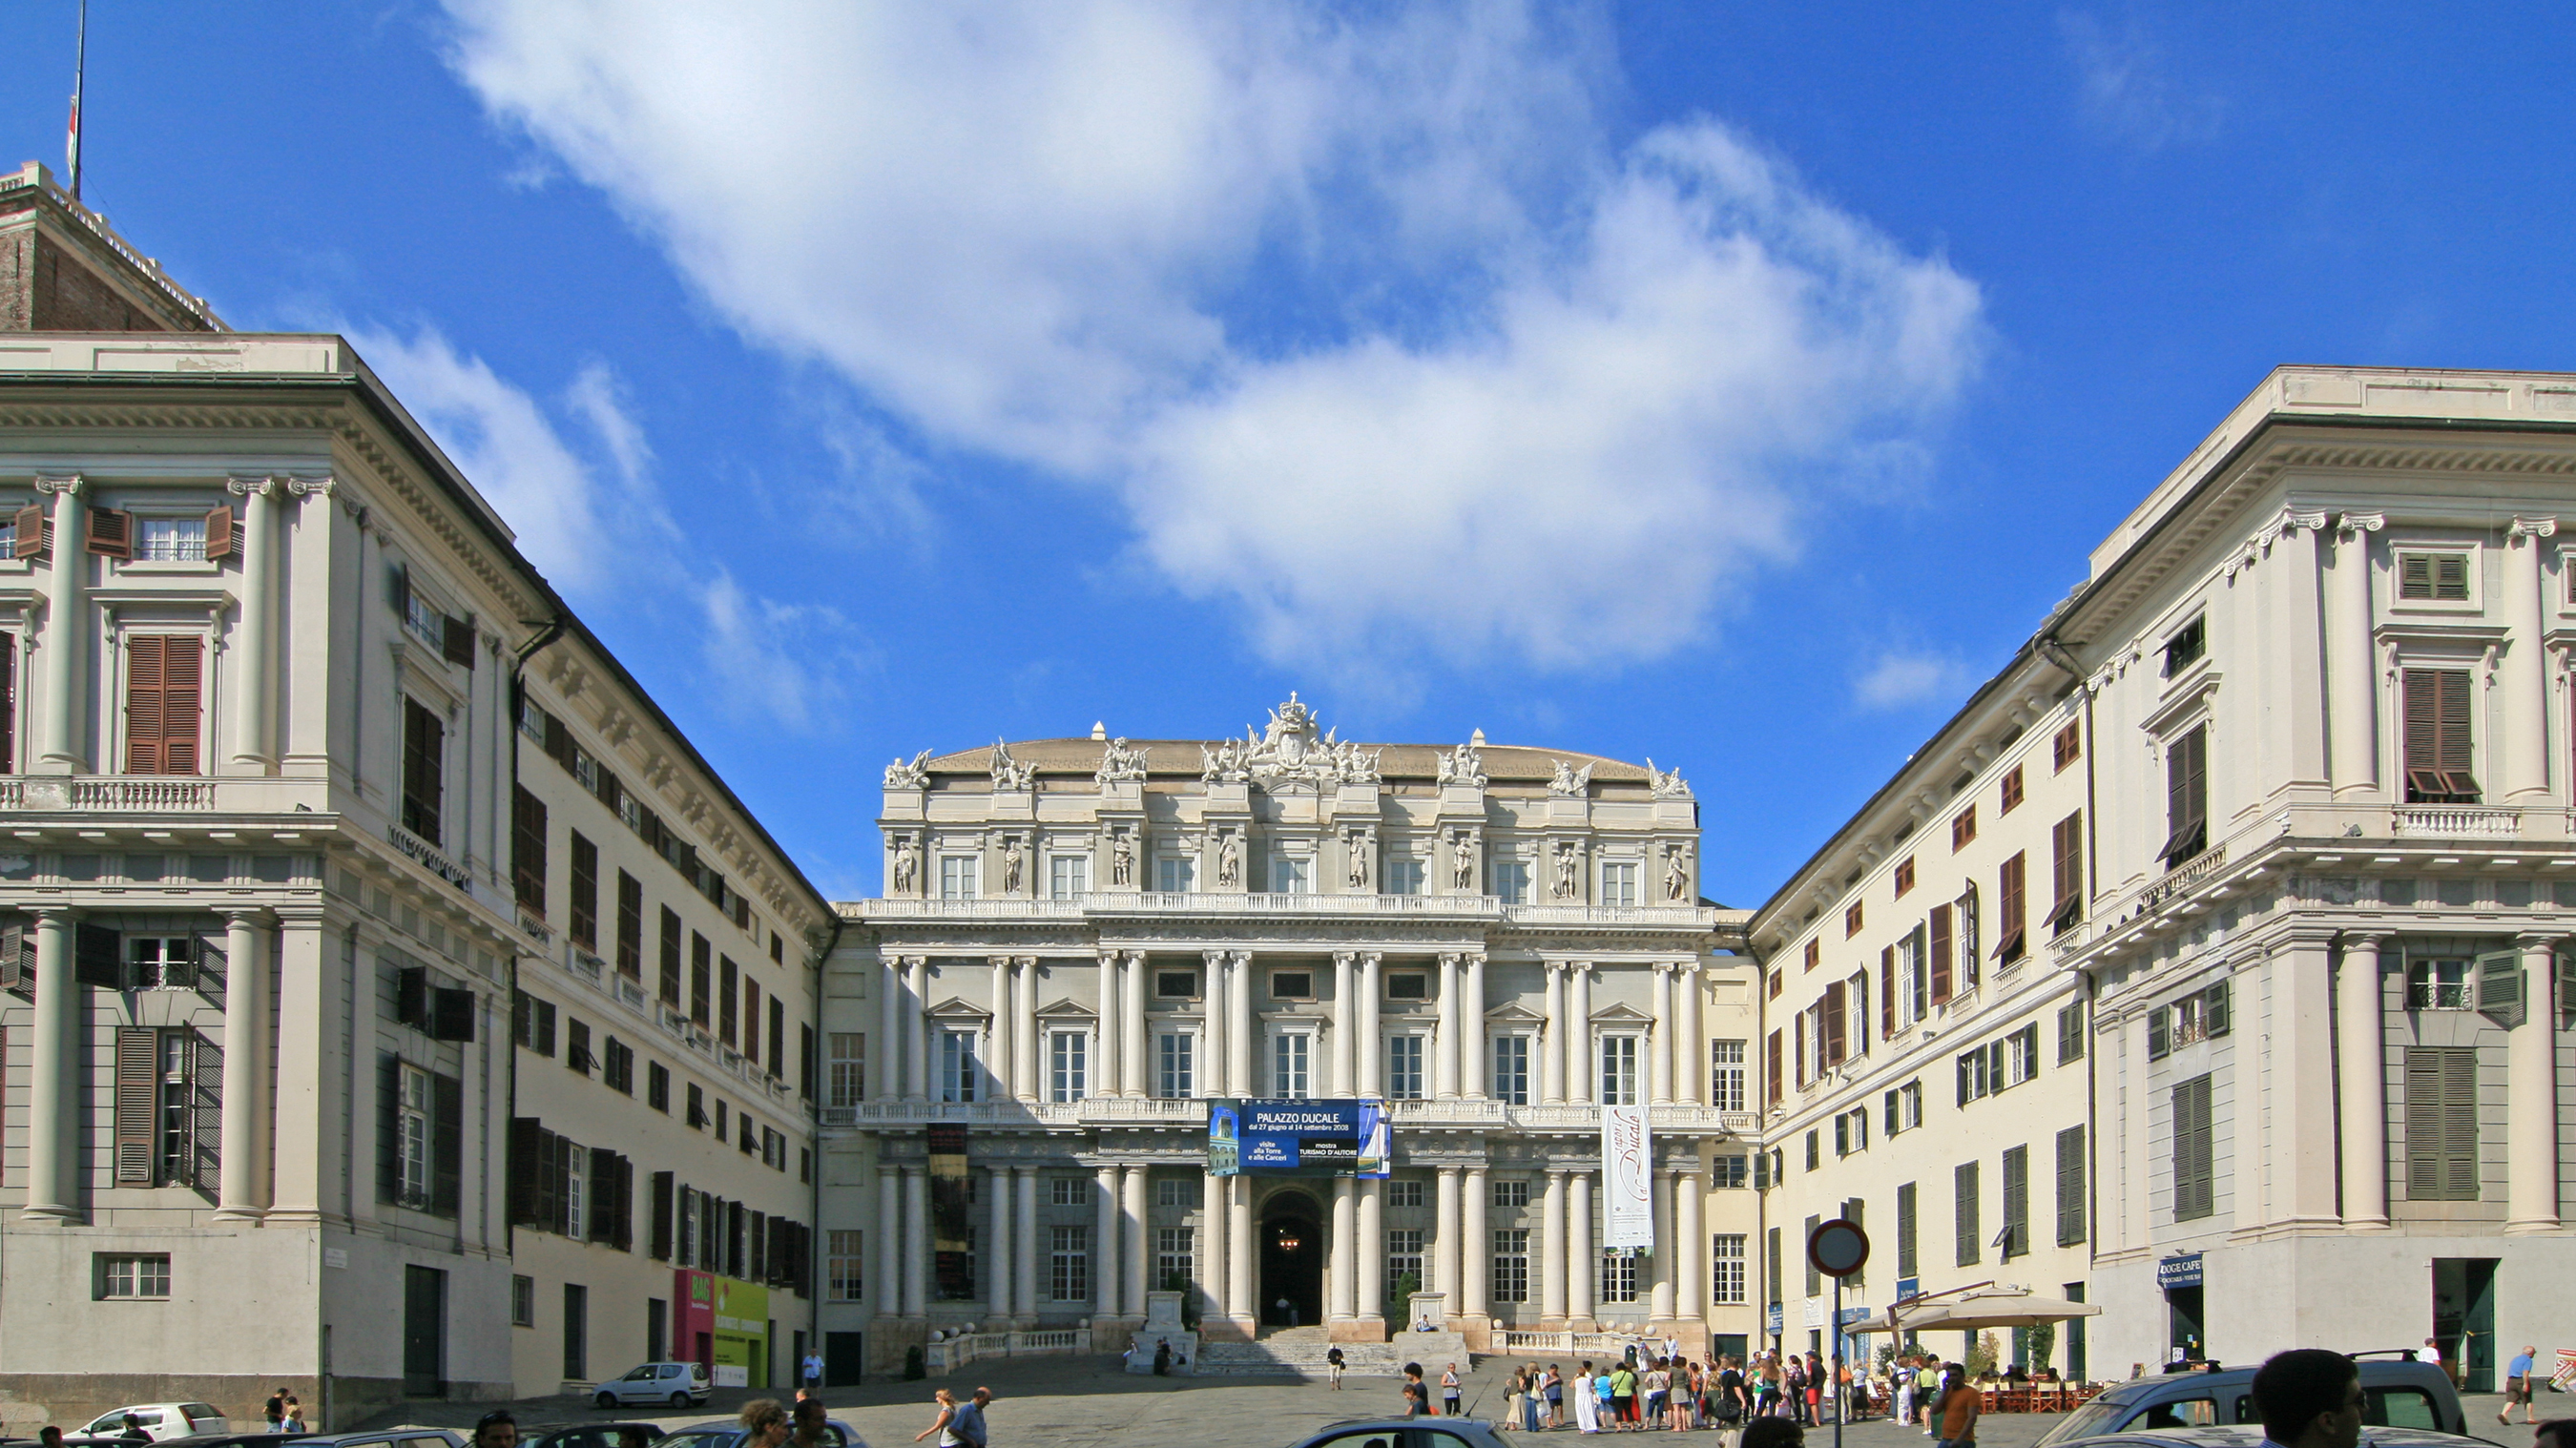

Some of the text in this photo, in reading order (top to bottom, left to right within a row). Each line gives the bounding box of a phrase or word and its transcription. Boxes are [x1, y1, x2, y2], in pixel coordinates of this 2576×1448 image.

[1257, 1113, 1340, 1124] PALAZZO DUCALE
[2160, 1263, 2181, 1273] DOGE
[693, 1275, 710, 1301] BAG
